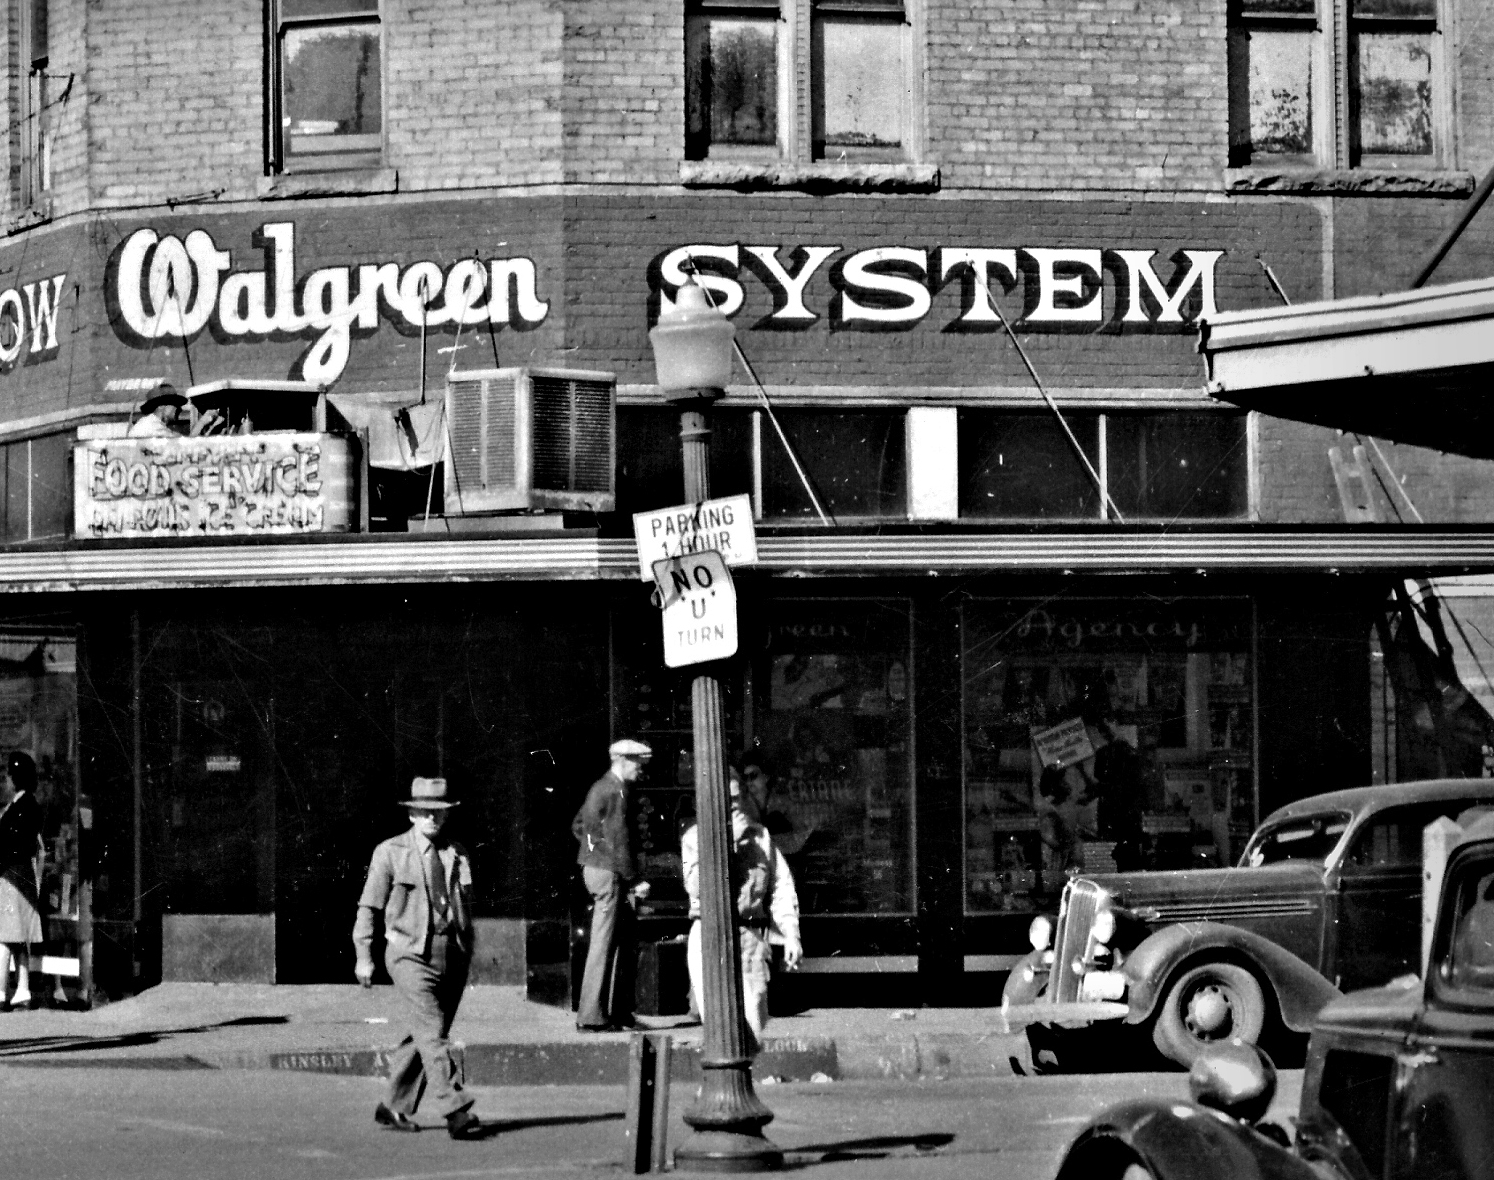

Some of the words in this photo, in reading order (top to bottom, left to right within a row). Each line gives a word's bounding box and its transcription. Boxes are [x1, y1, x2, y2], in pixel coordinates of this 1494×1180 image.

[109, 220, 550, 387] Walgreen
[652, 242, 1228, 328] SYSTEM
[88, 448, 172, 499] FOOD
[177, 444, 324, 498] SERVICE
[650, 504, 735, 538] PARKING
[661, 541, 670, 557] 1
[678, 530, 732, 555] HOUR
[669, 564, 713, 594] NO
[677, 623, 724, 647] TURN
[1017, 609, 1205, 646] Agency
